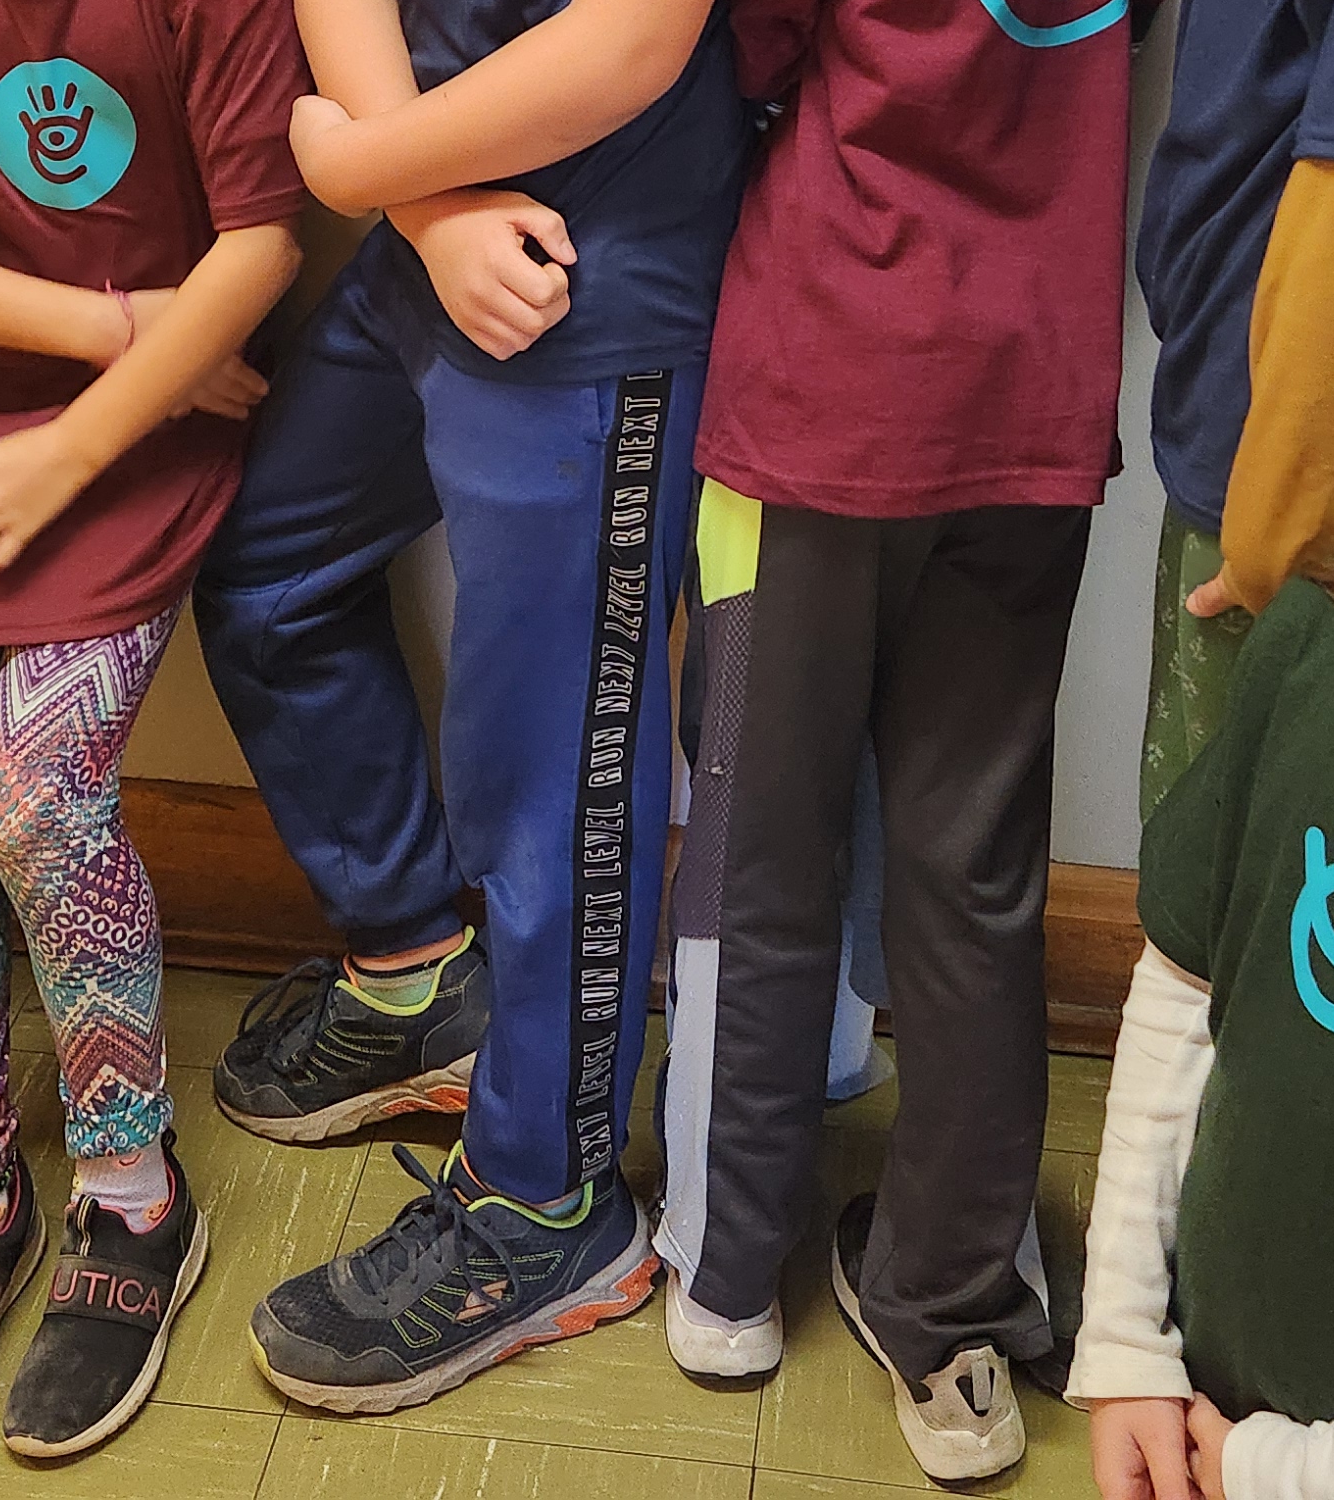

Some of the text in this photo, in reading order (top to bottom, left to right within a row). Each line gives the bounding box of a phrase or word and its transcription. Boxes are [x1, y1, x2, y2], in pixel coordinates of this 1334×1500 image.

[616, 396, 661, 473] NEXT
[610, 486, 650, 547] RUN
[603, 563, 647, 642] LEVEL
[594, 643, 636, 716] NEXT
[588, 727, 627, 788] RUN
[583, 801, 624, 878] LEVEL
[582, 891, 623, 957] NEXT
[582, 967, 620, 1021] RUN
[50, 1268, 160, 1322] UTICA
